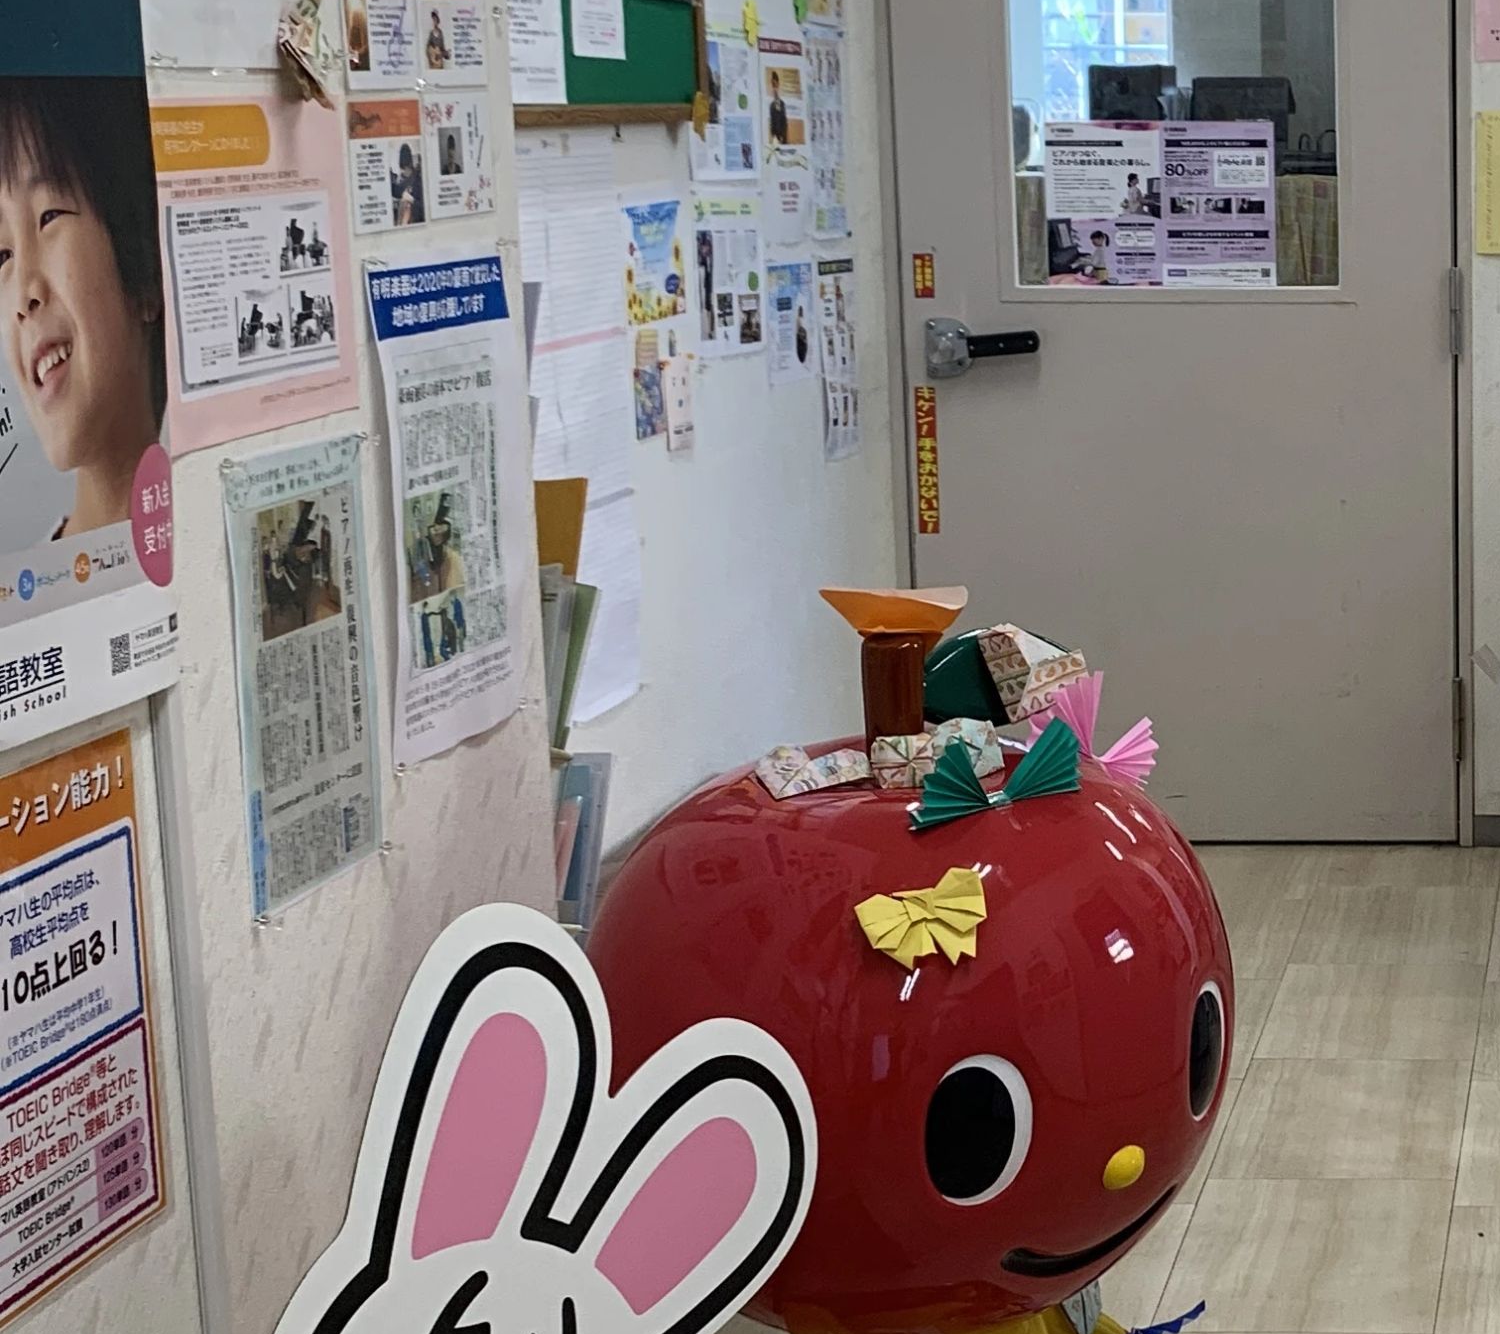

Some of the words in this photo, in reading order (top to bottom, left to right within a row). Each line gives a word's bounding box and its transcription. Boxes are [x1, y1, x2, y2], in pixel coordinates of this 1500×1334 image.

[0, 645, 65, 696] 語教室
[24, 684, 68, 714] School
[9, 901, 90, 961] 高校生平均点を
[1, 919, 119, 1010] 10点上回る!
[6, 1092, 50, 1133] TOEIC
[18, 1217, 44, 1243] TOEIC
